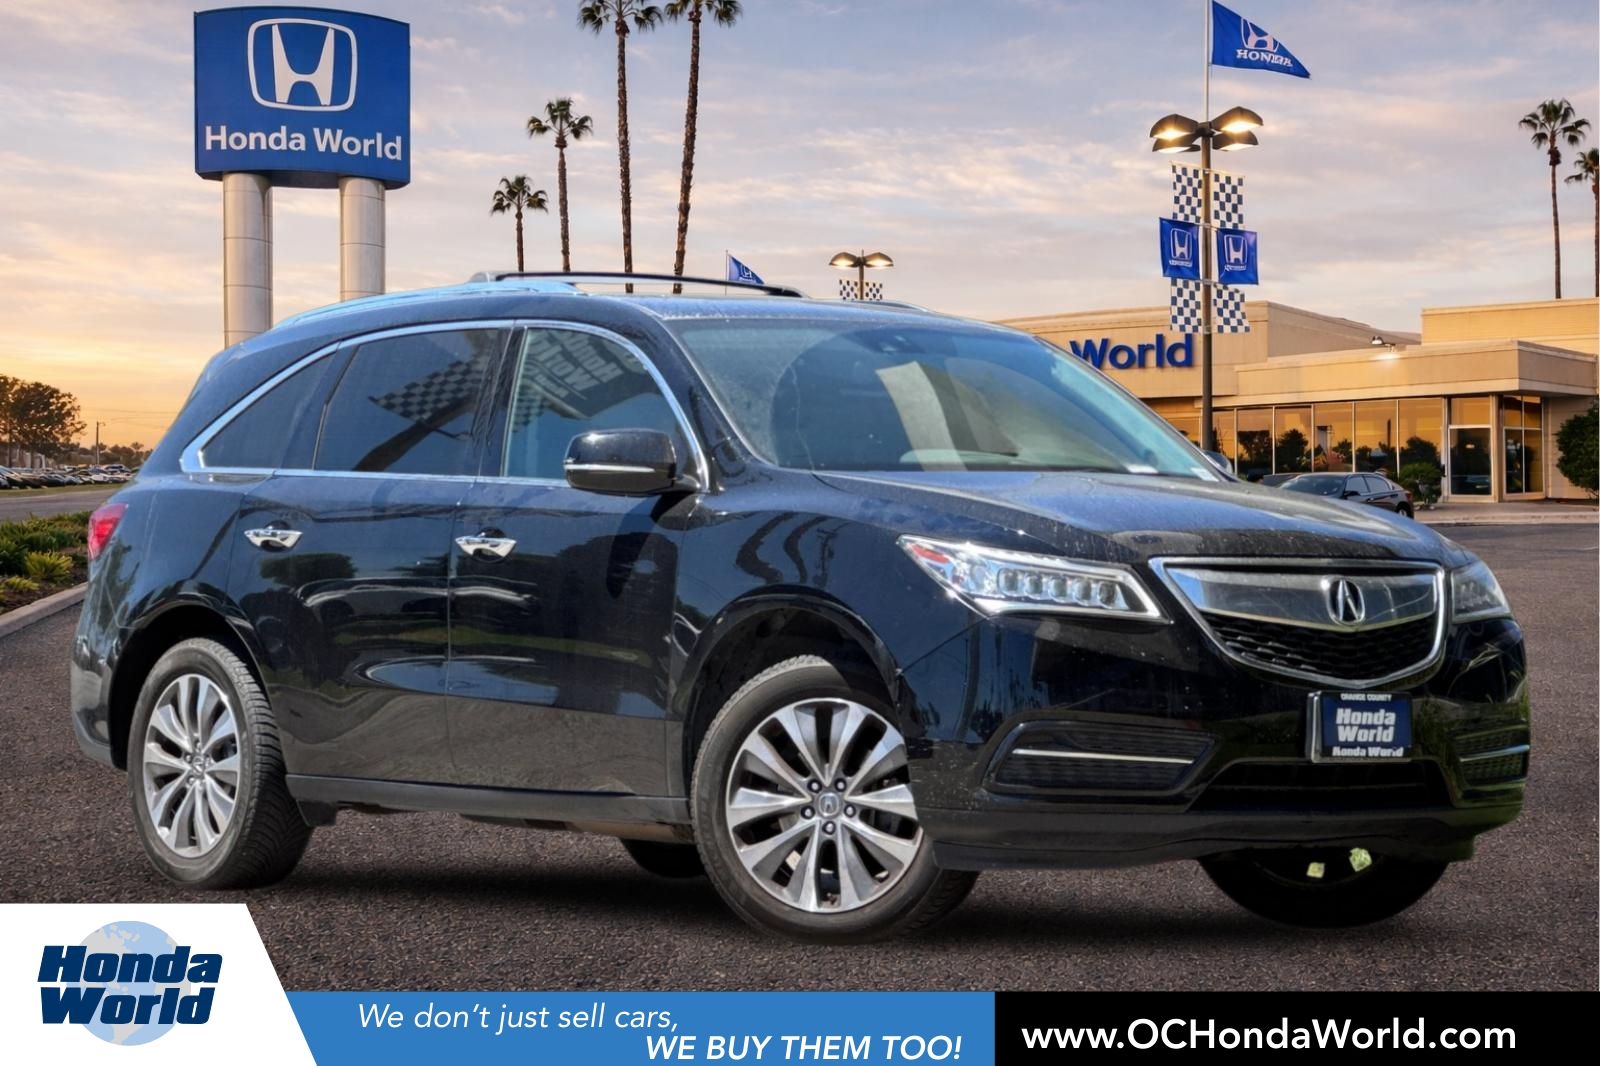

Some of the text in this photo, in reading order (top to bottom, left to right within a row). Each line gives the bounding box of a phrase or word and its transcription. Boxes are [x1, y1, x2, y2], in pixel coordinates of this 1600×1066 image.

[205, 125, 402, 161] Honda World
[1069, 333, 1193, 370] World
[1336, 708, 1396, 725] Honda
[1337, 725, 1394, 742] World
[1332, 746, 1366, 757] Honda
